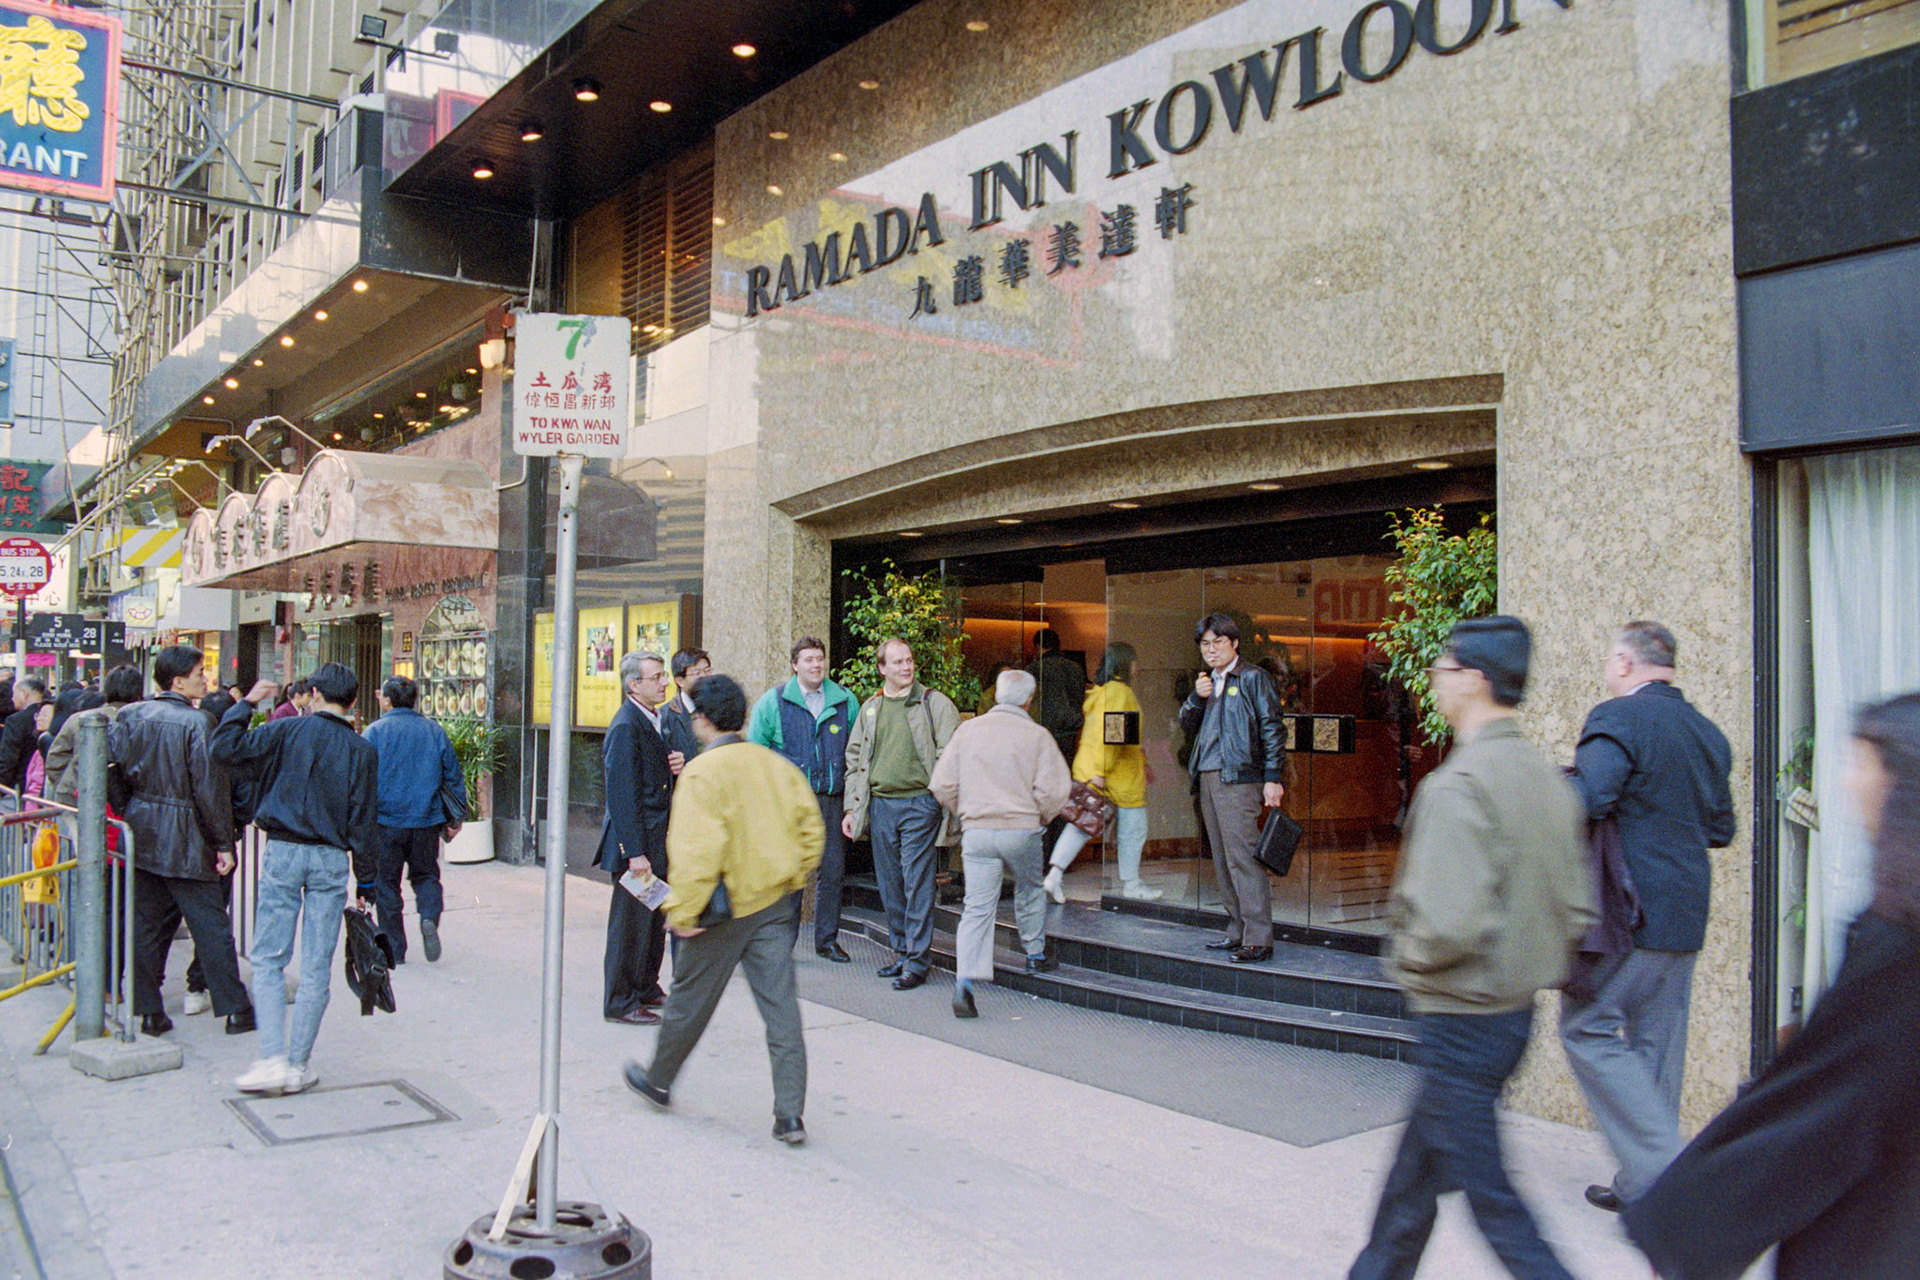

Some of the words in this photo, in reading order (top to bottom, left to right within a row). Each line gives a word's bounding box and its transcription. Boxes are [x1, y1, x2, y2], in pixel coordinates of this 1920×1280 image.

[0, 139, 88, 179] ANT
[745, 192, 944, 317] RAMADA
[967, 130, 1078, 232] INN
[908, 182, 1197, 320] 九龍華美達軒
[556, 320, 588, 360] 7
[530, 417, 548, 429] TO
[551, 417, 579, 430] KWA
[583, 418, 611, 430] WAN
[519, 432, 563, 444] WYLER
[566, 432, 620, 445] GARDEN
[0, 464, 33, 492] 記
[1, 548, 17, 556] BUS
[19, 548, 40, 556] STOP
[54, 616, 62, 628] 5
[83, 628, 97, 638] 28
